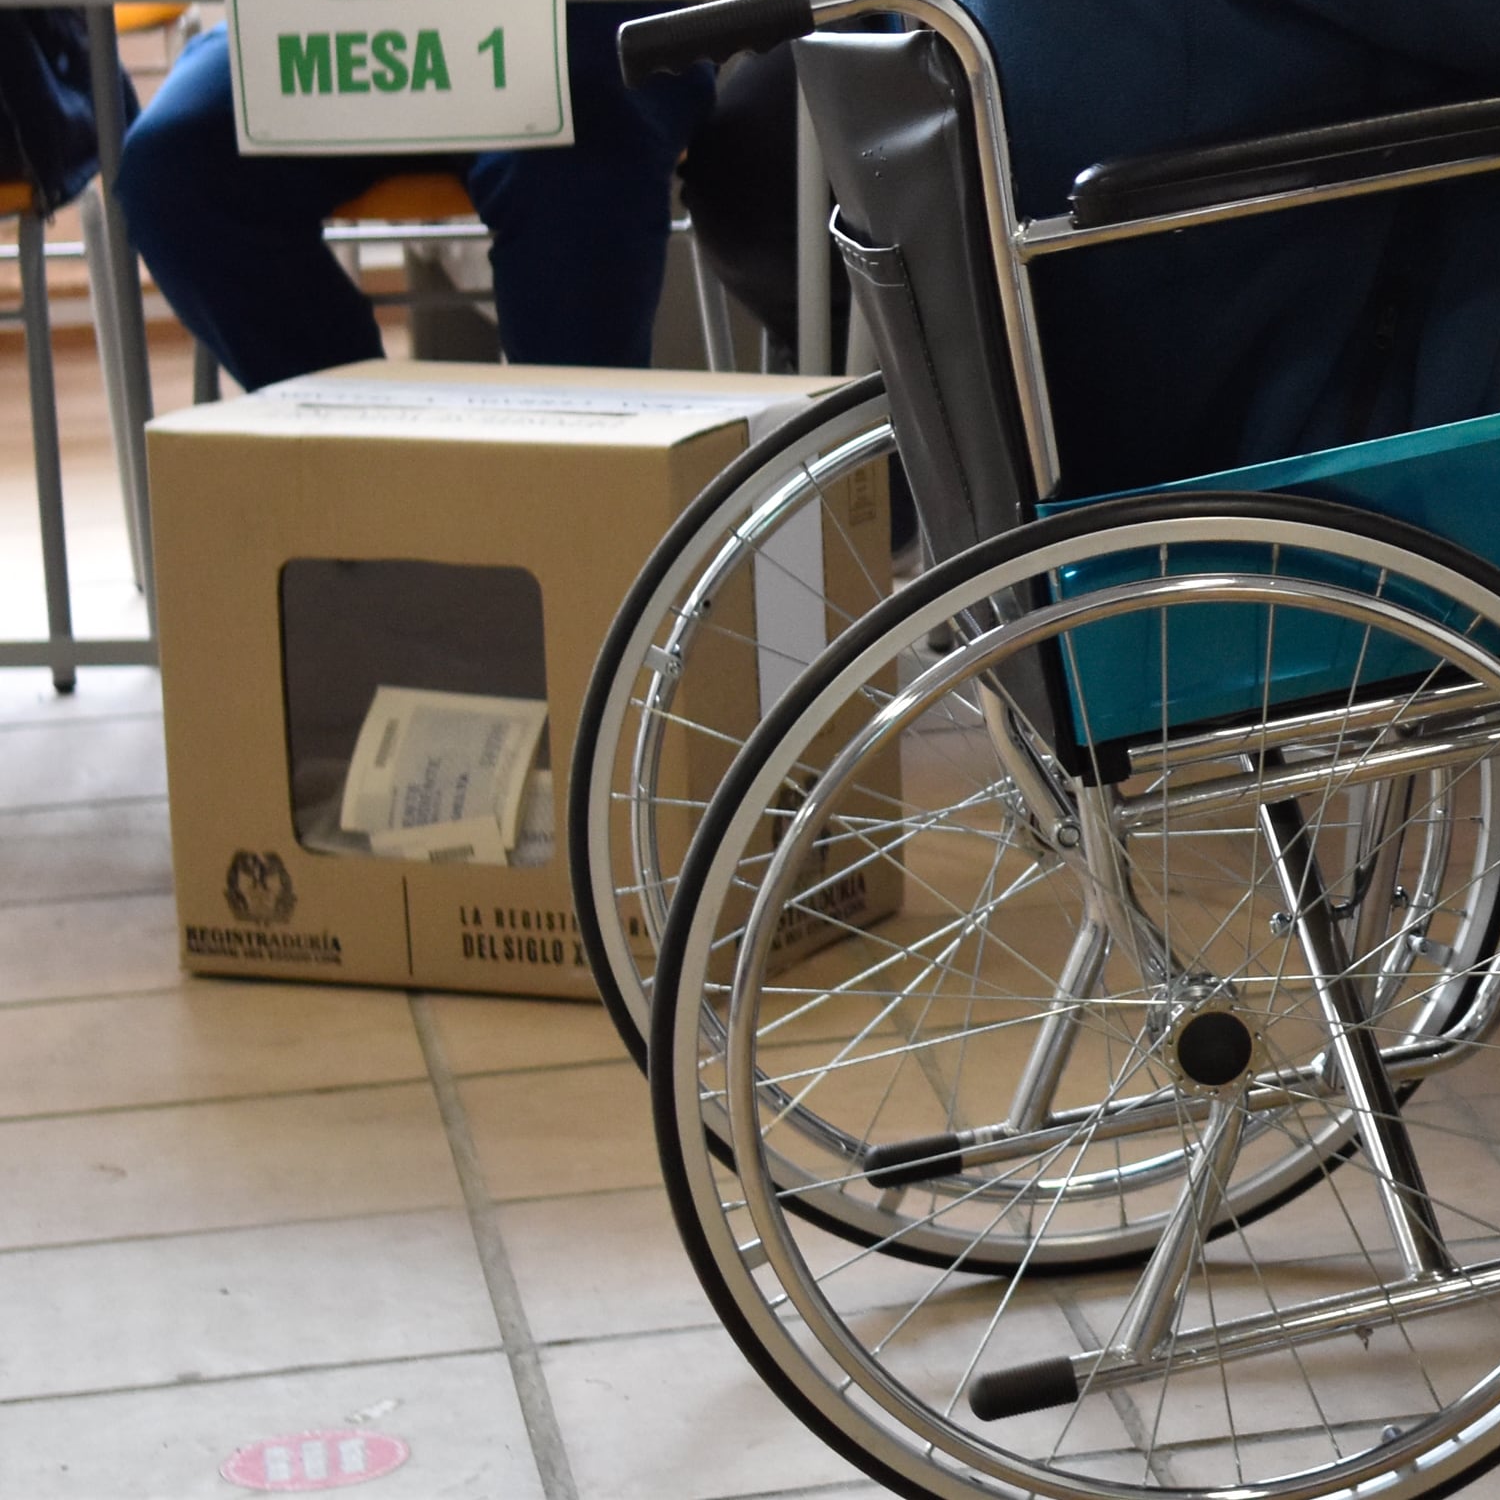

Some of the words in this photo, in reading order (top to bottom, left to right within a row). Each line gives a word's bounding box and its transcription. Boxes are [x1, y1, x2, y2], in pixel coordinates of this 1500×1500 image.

[277, 28, 452, 95] MESA
[477, 26, 506, 90] 1
[462, 933, 499, 962] DEL
[503, 935, 565, 966] SIGLO
